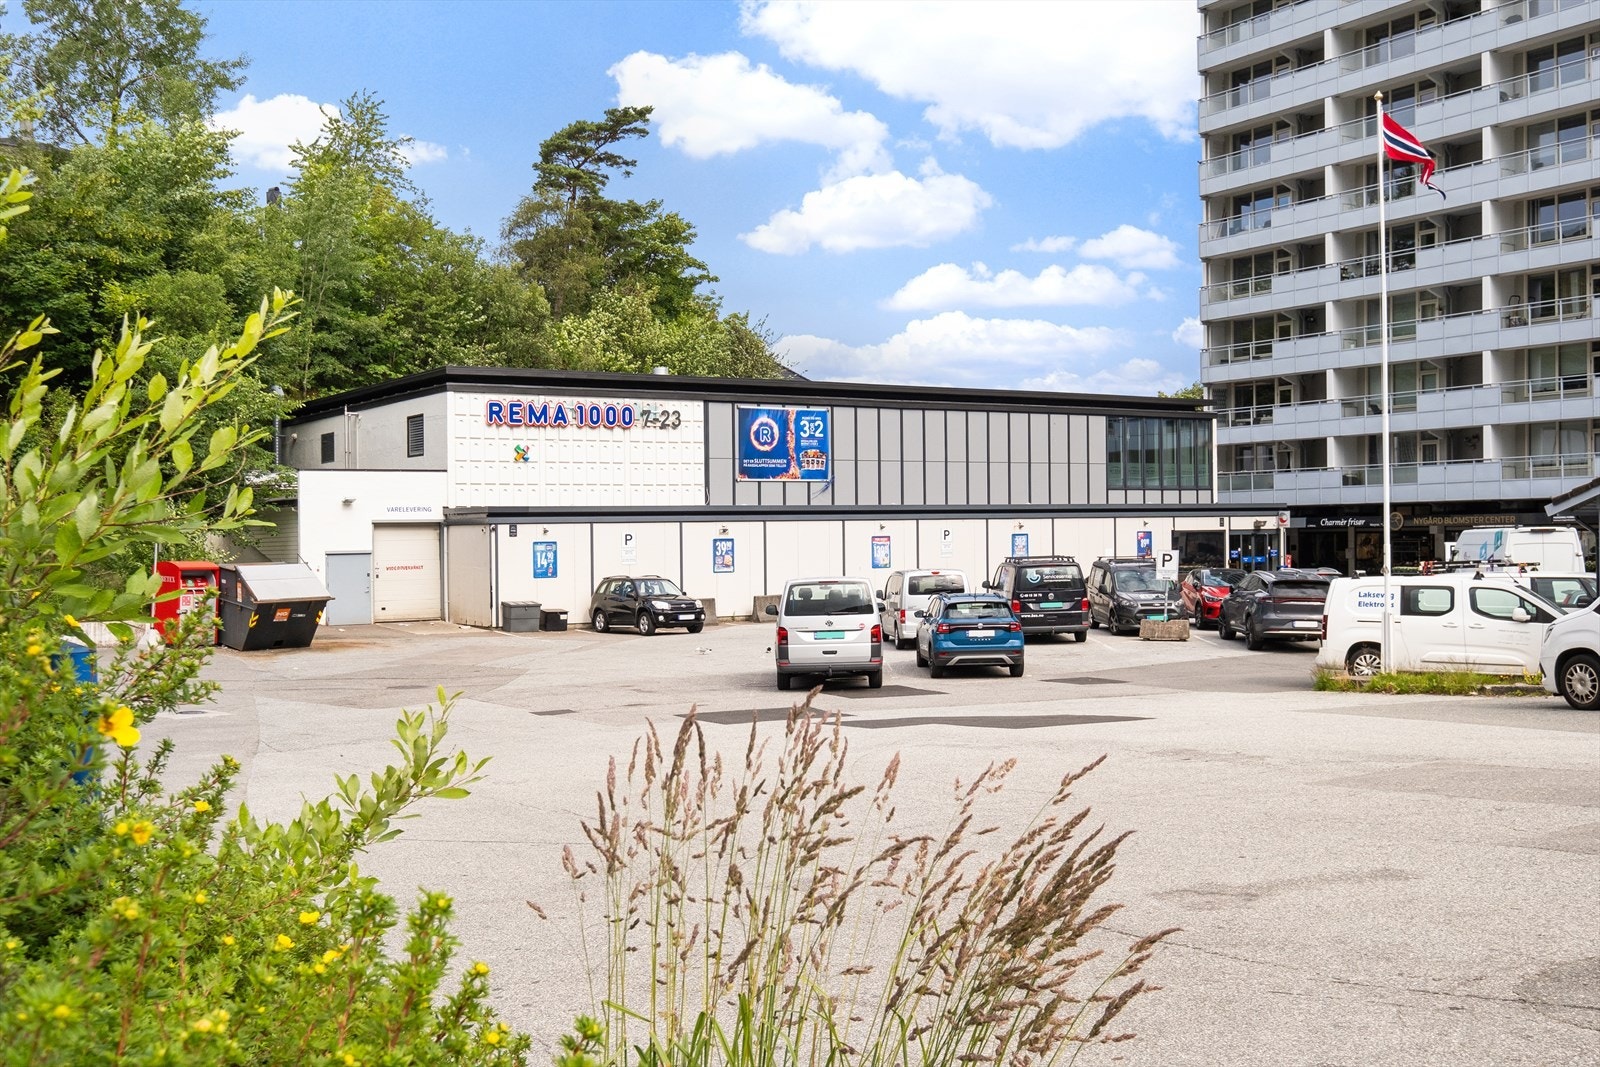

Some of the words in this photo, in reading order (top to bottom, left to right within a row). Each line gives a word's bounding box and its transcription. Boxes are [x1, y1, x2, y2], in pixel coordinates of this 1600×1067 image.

[487, 400, 569, 427] REMA
[575, 404, 635, 428] 1000
[641, 410, 682, 429] 7-23
[760, 427, 772, 443] R
[800, 420, 810, 438] 3
[815, 420, 824, 438] 2
[1413, 515, 1443, 525] NYGÅRD
[1444, 516, 1484, 525] BLOMSTER
[1485, 515, 1516, 524] CENTER
[624, 533, 633, 546] P
[943, 529, 950, 540] P
[716, 541, 727, 556] 39
[536, 551, 548, 568] 14
[1162, 553, 1173, 568] P
[1358, 591, 1395, 600] Laksevg
